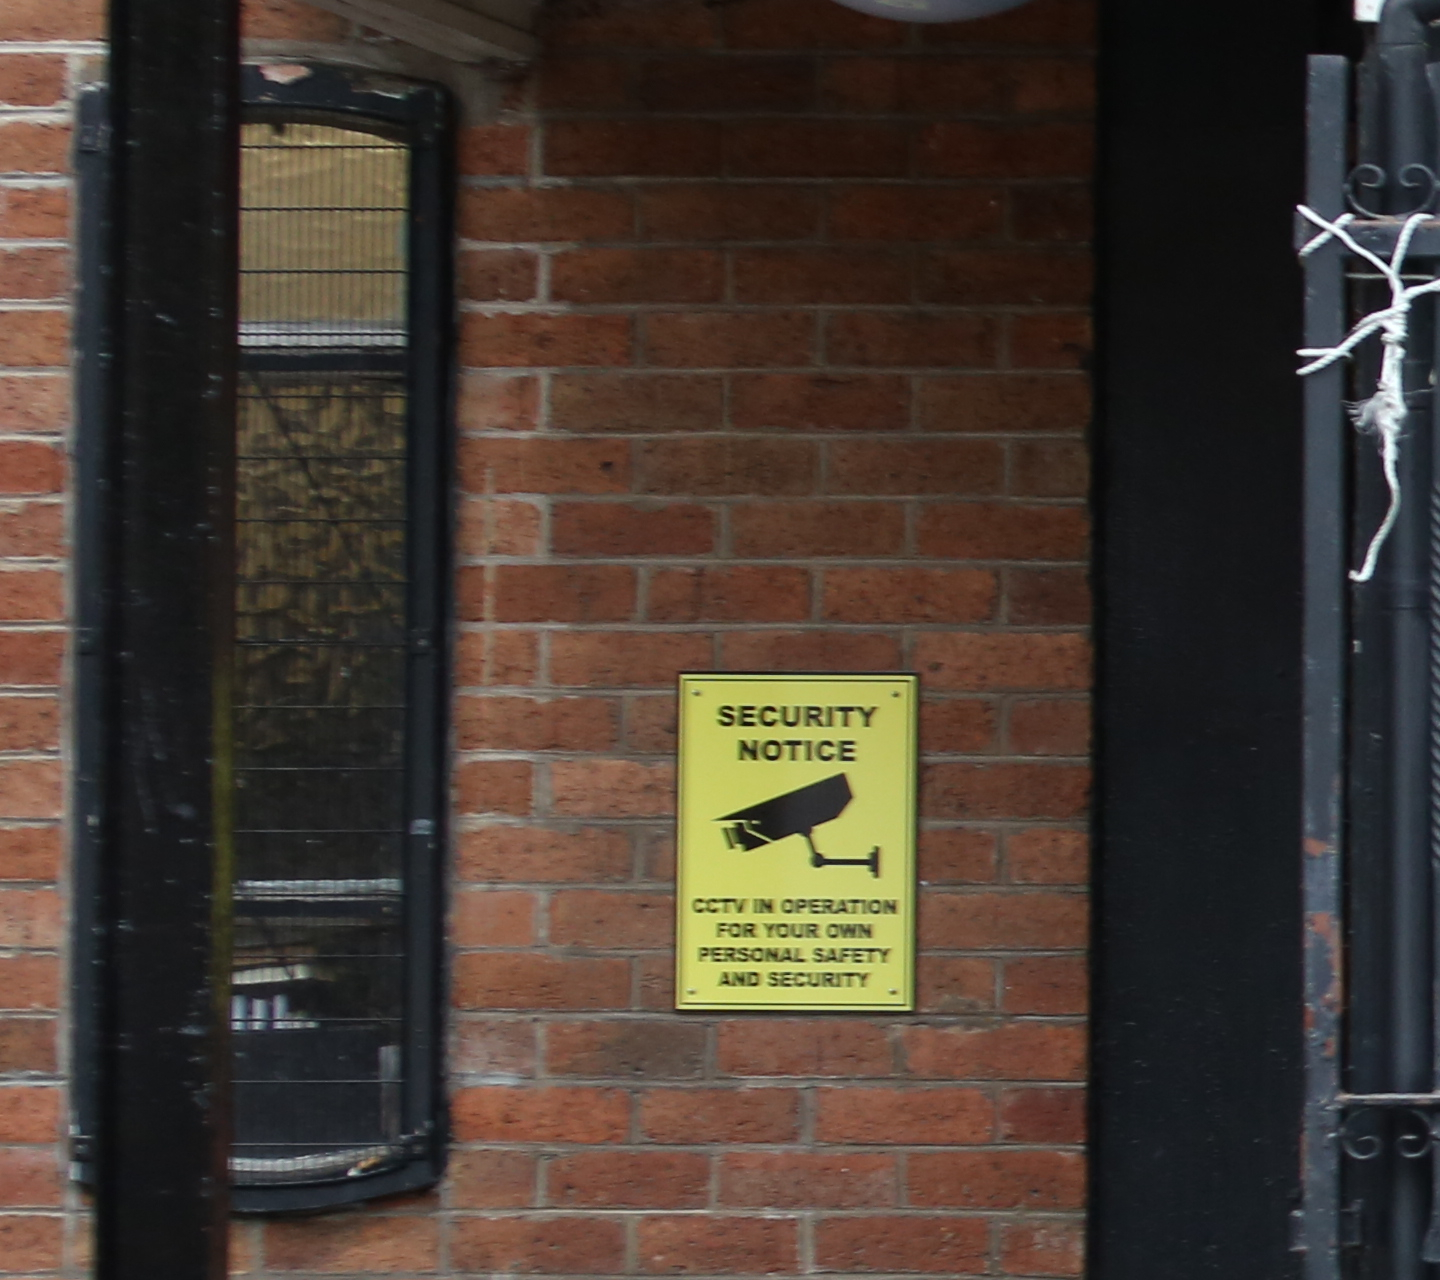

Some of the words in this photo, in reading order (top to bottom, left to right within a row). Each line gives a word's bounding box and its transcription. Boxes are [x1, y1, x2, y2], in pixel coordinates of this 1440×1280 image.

[716, 705, 878, 728] SECURITY
[738, 739, 857, 762] NOTICE
[692, 898, 746, 915] CCTV
[753, 898, 774, 915] IN
[781, 898, 898, 915] OPERATION
[716, 922, 757, 939] FOR
[763, 922, 820, 939] YOUR
[826, 923, 873, 939] OWN
[697, 946, 807, 963] PERSONAL
[812, 947, 891, 964] SAFETY
[718, 971, 760, 988] AND
[767, 971, 870, 988] SECURITY
